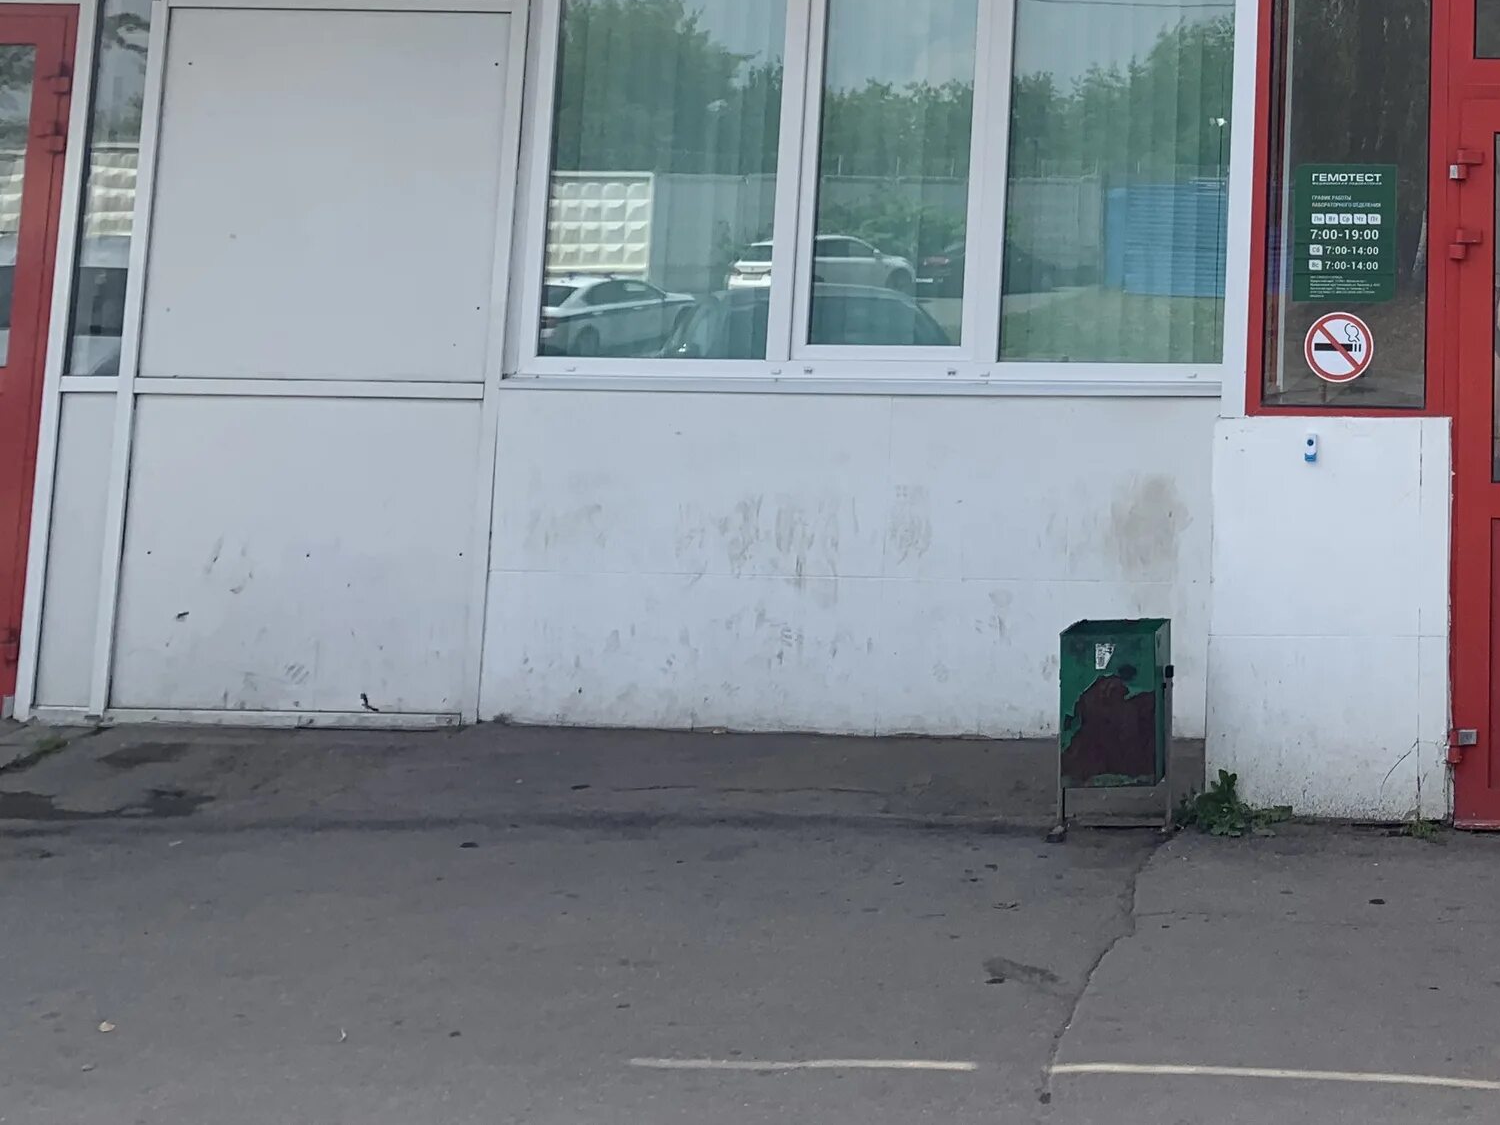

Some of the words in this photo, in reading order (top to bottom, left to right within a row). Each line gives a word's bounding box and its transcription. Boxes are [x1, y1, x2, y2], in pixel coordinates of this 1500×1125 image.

[1312, 173, 1382, 182] ГЕМОТЕСТ
[1310, 229, 1379, 240] 7:00-19:00
[1325, 246, 1379, 255] 7:00-14:00
[1325, 261, 1379, 270] 7:00-14:00
